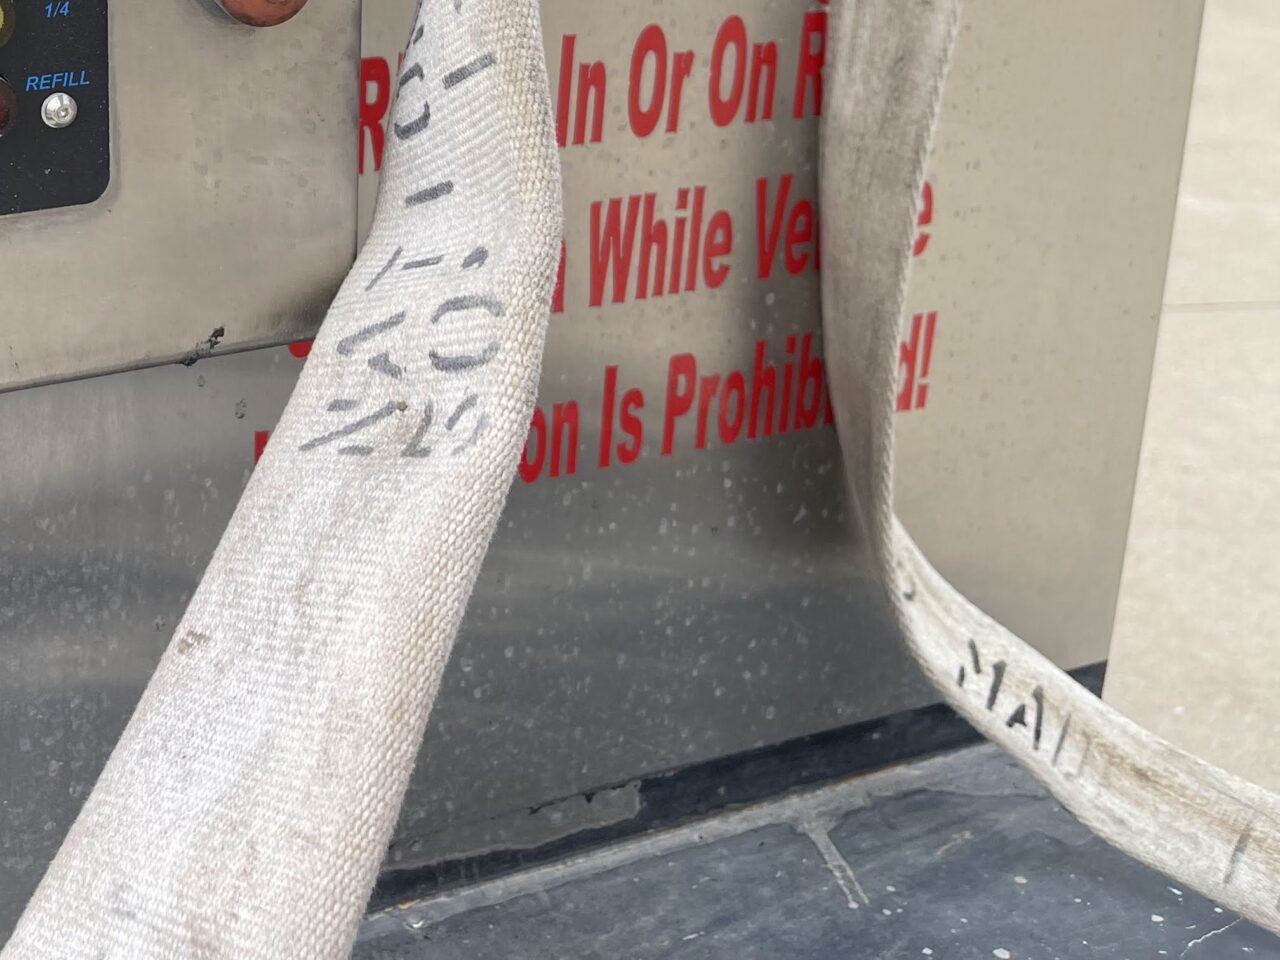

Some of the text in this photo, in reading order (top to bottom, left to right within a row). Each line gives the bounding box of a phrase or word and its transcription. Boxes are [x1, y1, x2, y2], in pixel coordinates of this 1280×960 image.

[44, 1, 70, 18] 1/4
[25, 70, 90, 91] REFILL
[555, 34, 606, 148] In
[628, 24, 695, 138] Or
[708, 15, 777, 127] On
[588, 186, 733, 308] While
[597, 365, 645, 469] Is
[661, 311, 938, 457] Prohibd!
